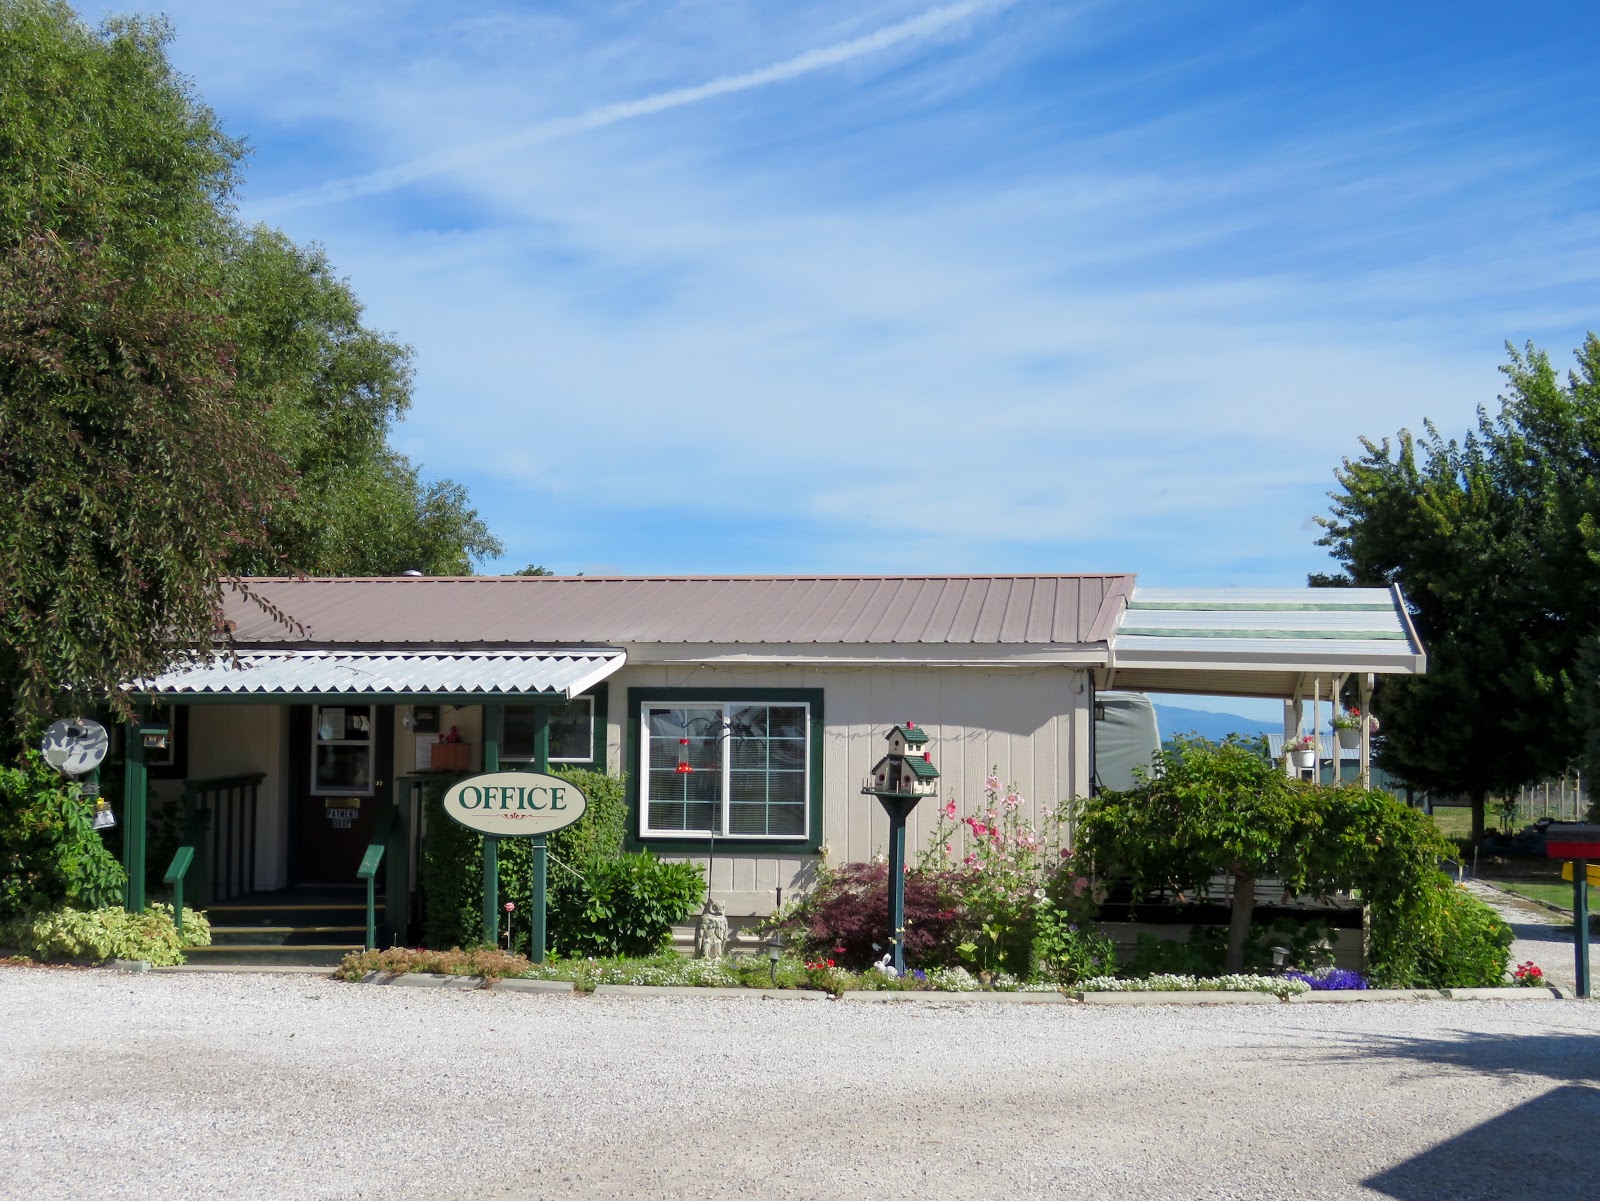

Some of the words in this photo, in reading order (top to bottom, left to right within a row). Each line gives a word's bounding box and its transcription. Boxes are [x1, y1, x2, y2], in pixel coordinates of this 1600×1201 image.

[458, 786, 567, 810] OFFICE
[327, 809, 358, 818] PAYMENT
[333, 818, 351, 827] DROP
